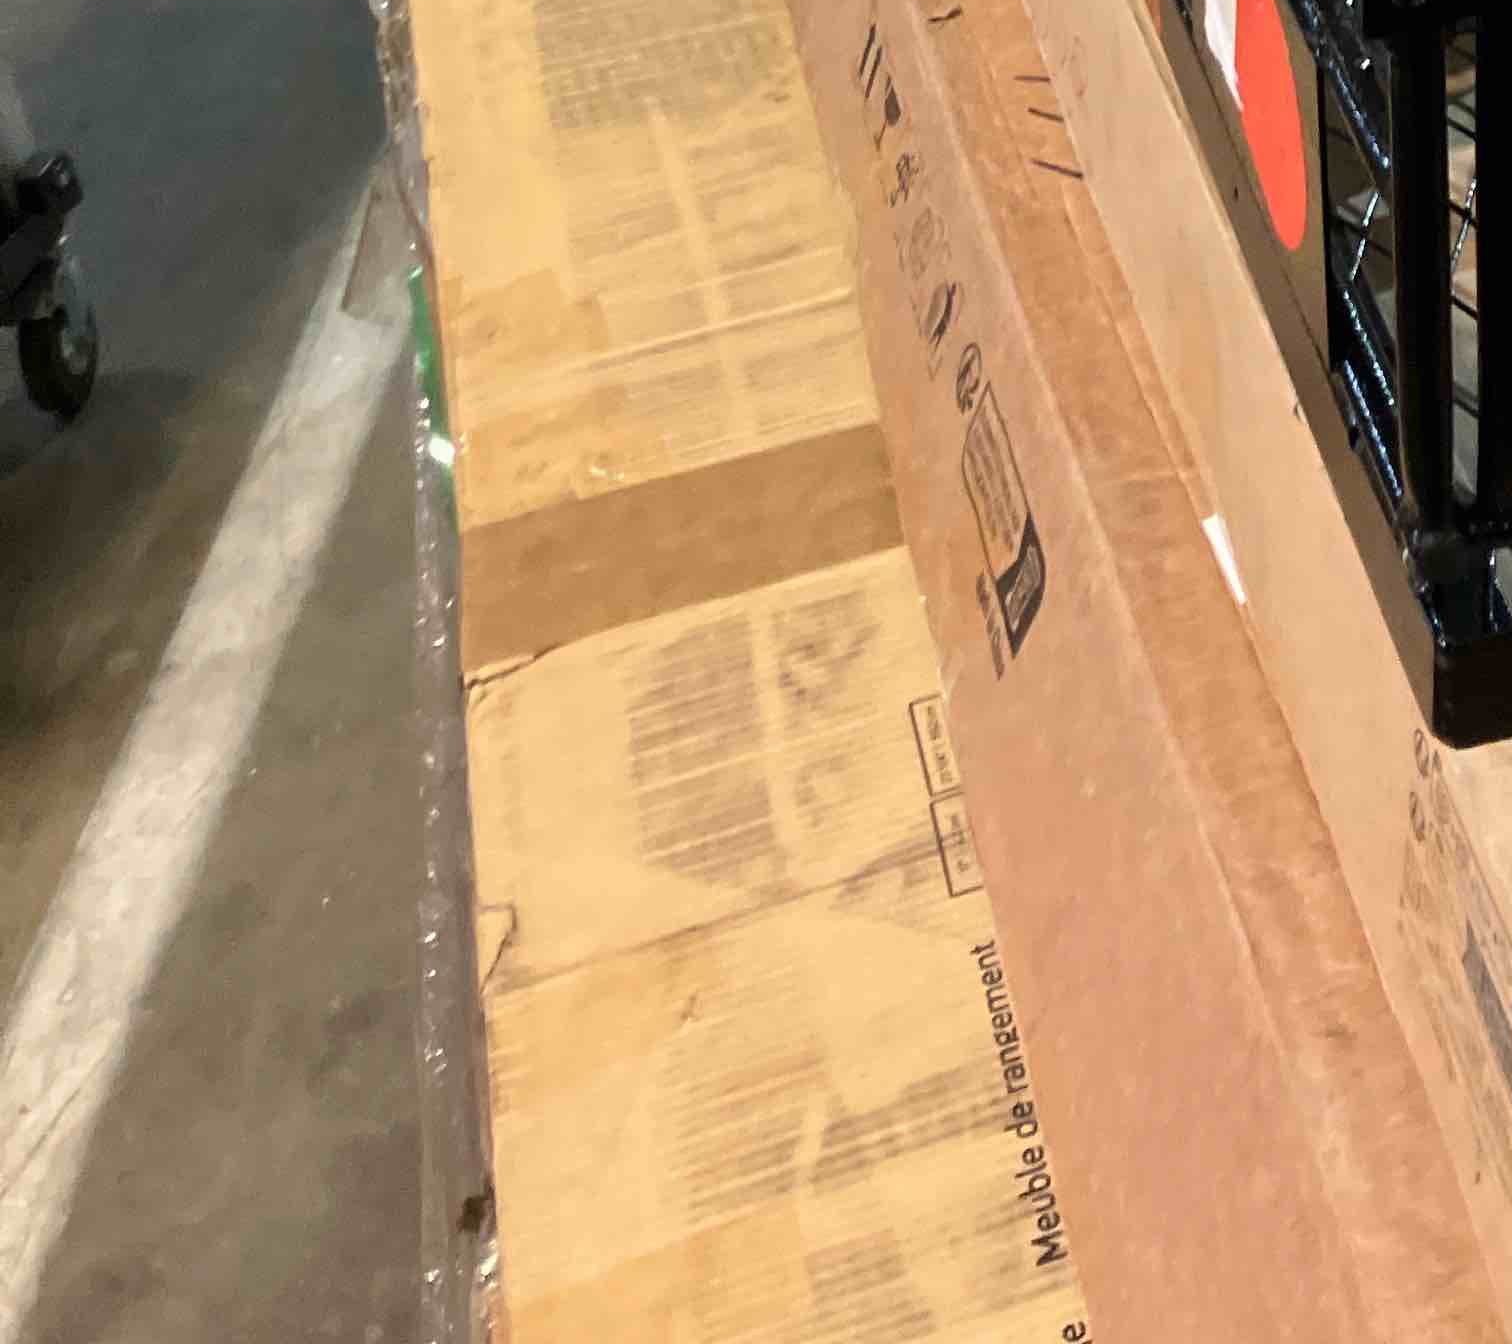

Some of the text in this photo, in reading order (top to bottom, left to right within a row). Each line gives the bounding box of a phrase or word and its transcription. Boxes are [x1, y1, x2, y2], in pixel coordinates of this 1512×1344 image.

[970, 938, 1069, 1267] Meuble de rangement
